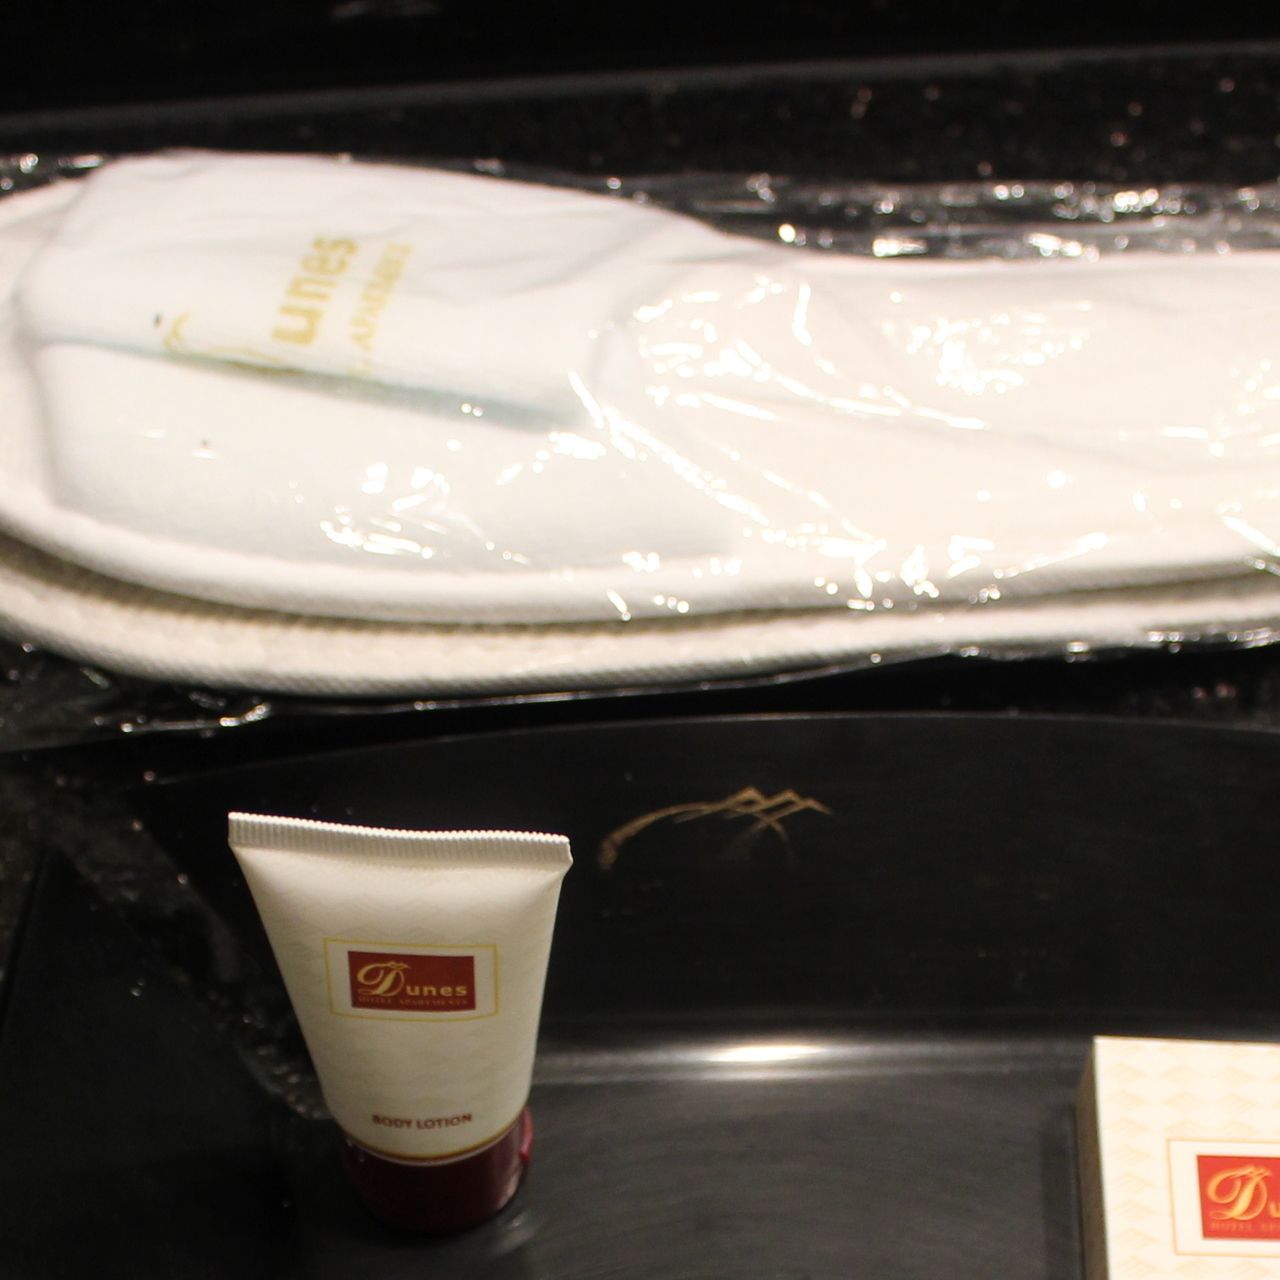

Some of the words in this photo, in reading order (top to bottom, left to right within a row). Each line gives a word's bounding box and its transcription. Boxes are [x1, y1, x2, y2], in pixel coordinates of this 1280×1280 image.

[356, 960, 468, 997] Dunes
[371, 1114, 412, 1129] BODY
[416, 1113, 472, 1129] LOTION
